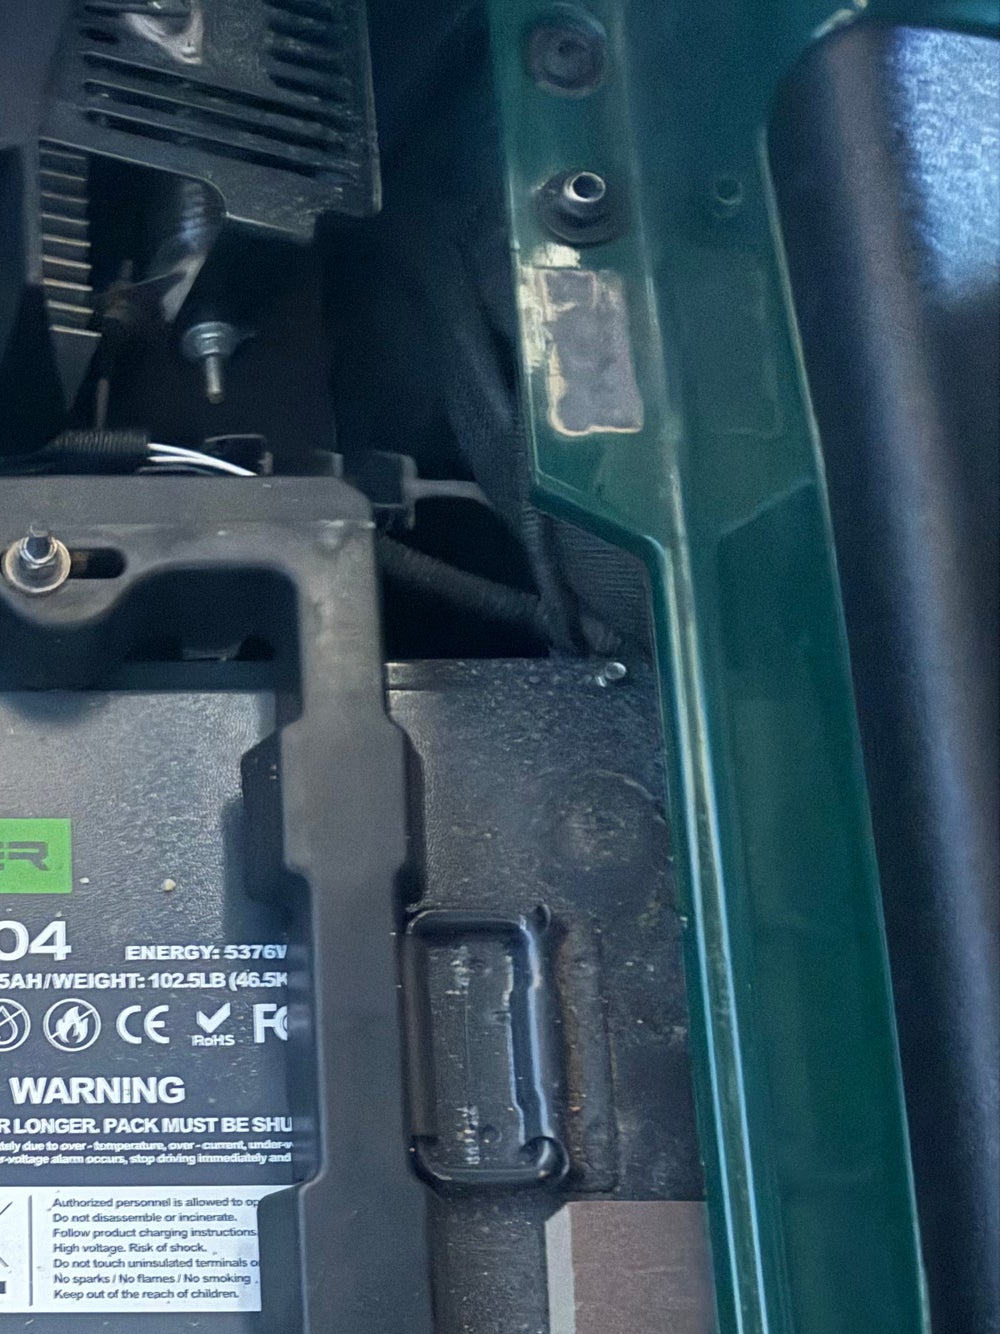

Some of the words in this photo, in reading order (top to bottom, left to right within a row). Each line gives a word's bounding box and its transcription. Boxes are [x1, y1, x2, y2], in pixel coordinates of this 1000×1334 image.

[125, 945, 220, 961] ENERGY:
[149, 972, 225, 988] 102.5LB
[116, 1005, 170, 1044] CE
[192, 1034, 235, 1046] RoHS
[9, 1077, 185, 1104] WARNING
[13, 1118, 99, 1134] LONGER.
[103, 1118, 159, 1134] PACK
[162, 1117, 218, 1133] MUST
[221, 1117, 249, 1132] BE
[252, 1117, 292, 1132] SHU
[24, 1141, 43, 1151] due
[46, 1141, 59, 1151] to
[50, 1154, 83, 1164] alarm
[85, 1155, 128, 1165] occurs,
[130, 1154, 155, 1165] stop
[156, 1153, 196, 1165] driving
[198, 1153, 267, 1165] immediately
[268, 1152, 292, 1162] and
[52, 1198, 113, 1208] Authorized
[115, 1198, 171, 1209] personnel
[173, 1198, 183, 1207] is
[185, 1198, 229, 1207] allowed
[231, 1199, 243, 1207] to
[53, 1213, 69, 1222] Do
[71, 1214, 90, 1222] not
[92, 1213, 162, 1222] disassemble
[179, 1212, 238, 1222] incinerate.
[53, 1228, 90, 1237] Follow
[92, 1228, 136, 1239] product
[139, 1228, 188, 1239] charging
[190, 1227, 258, 1237] instructions.
[53, 1243, 80, 1254] High
[83, 1243, 126, 1254] voltage.
[128, 1243, 154, 1252] Risk
[156, 1243, 168, 1252] of
[170, 1243, 207, 1252] shock.
[53, 1259, 69, 1268] Do
[71, 1259, 90, 1268] not
[93, 1259, 125, 1268] touch
[128, 1258, 192, 1268] uninsulated
[196, 1258, 248, 1267] terminals
[53, 1274, 71, 1283] No
[73, 1274, 110, 1285] sparks
[119, 1274, 135, 1283] No
[137, 1273, 175, 1283] flames
[184, 1274, 200, 1283] No
[202, 1274, 251, 1285] smoking
[54, 1290, 84, 1300] Keep
[86, 1290, 105, 1299] out
[107, 1289, 119, 1299] of
[121, 1289, 139, 1298] the
[142, 1289, 174, 1299] reach
[177, 1289, 189, 1298] of
[191, 1289, 239, 1298] children.
